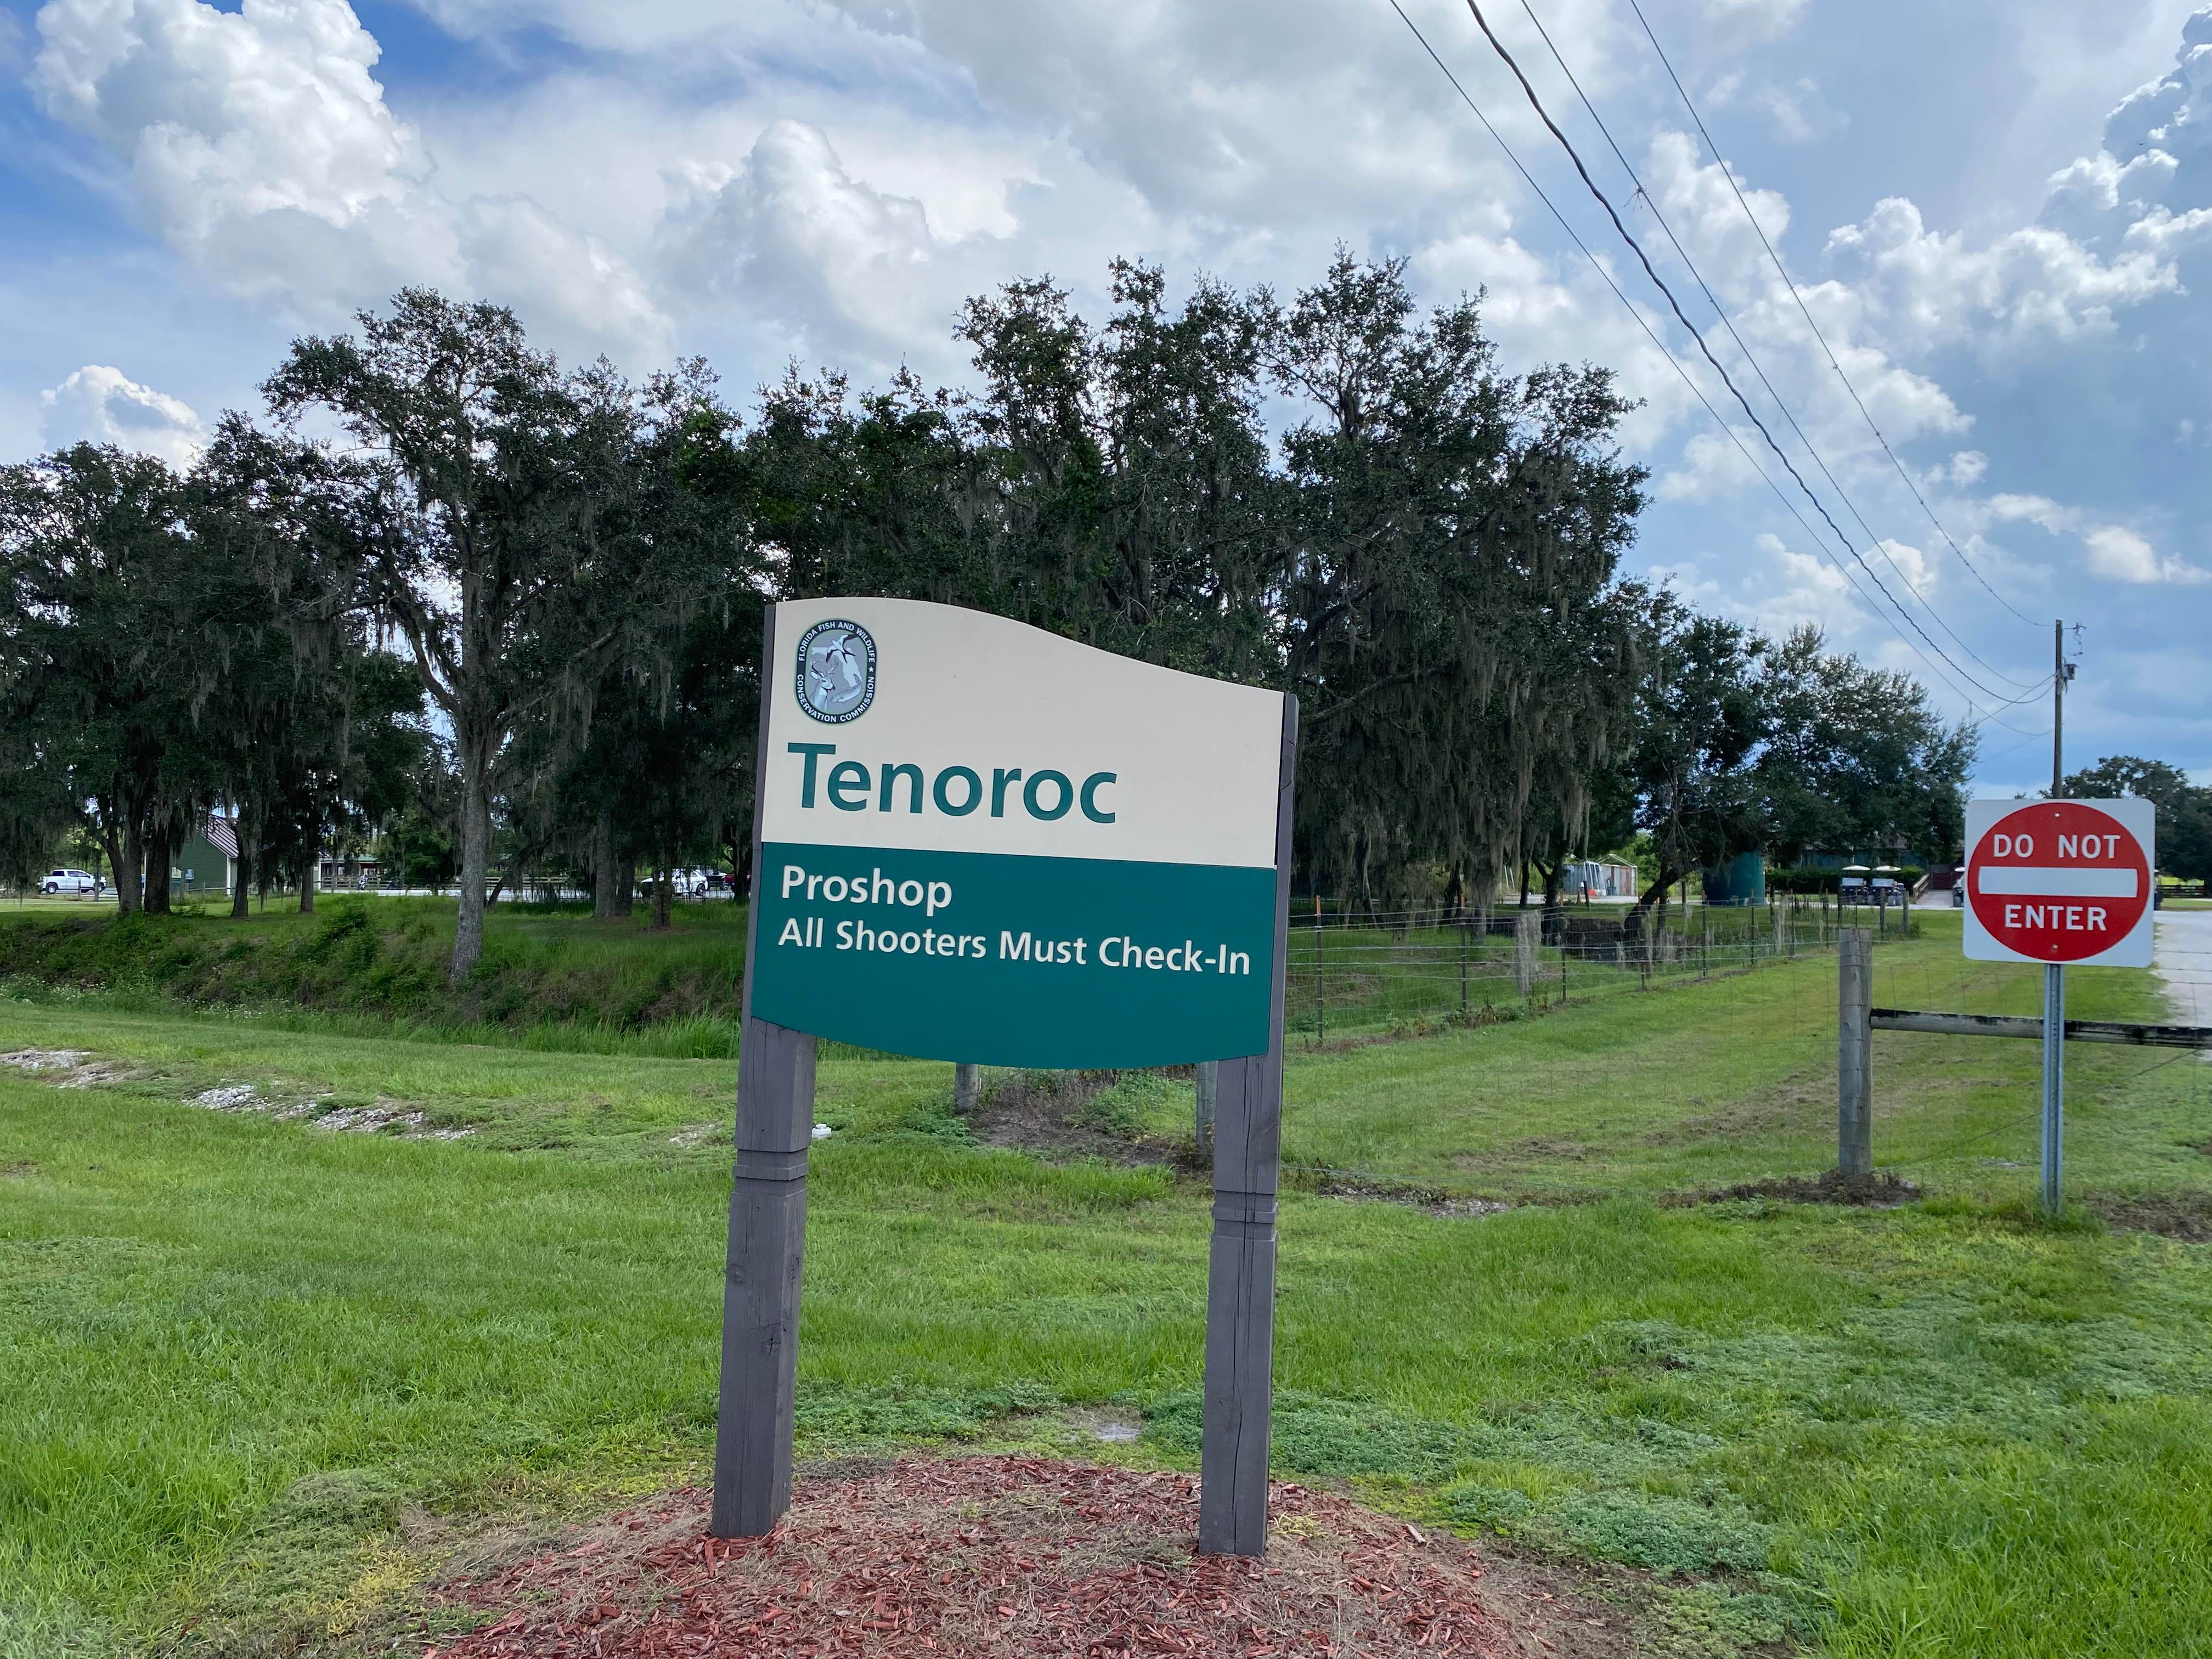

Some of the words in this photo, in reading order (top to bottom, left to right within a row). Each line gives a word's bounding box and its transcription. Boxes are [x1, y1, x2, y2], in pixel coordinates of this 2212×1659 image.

[798, 629, 818, 661] FLORIDA
[818, 622, 836, 631] FISH
[838, 622, 855, 631] AND
[856, 628, 876, 663] WILDLIFE
[797, 674, 837, 723] CONSERVATION
[839, 676, 874, 722] COMMISSION
[787, 742, 1118, 824] Tenoroc
[1993, 834, 2034, 858] DO
[2058, 834, 2121, 859] NOT
[782, 865, 952, 917] Proshop
[2005, 904, 2107, 931] ENTER
[778, 917, 823, 947] All
[836, 920, 987, 958] Shooters
[999, 930, 1087, 965] Must
[1098, 936, 1250, 975] Check-In
